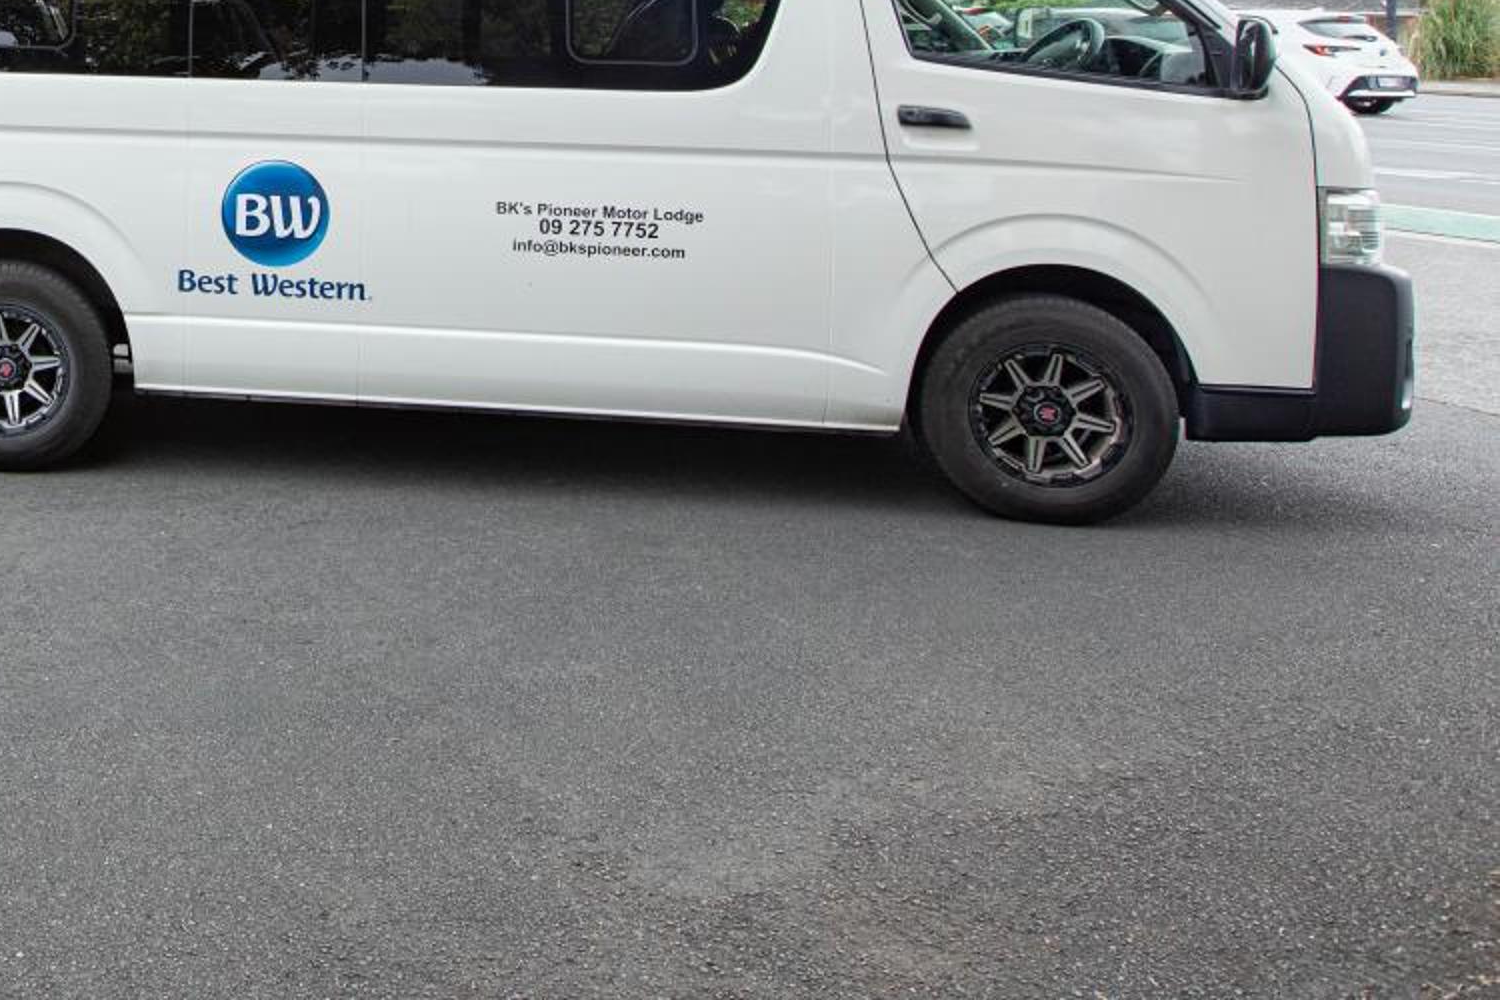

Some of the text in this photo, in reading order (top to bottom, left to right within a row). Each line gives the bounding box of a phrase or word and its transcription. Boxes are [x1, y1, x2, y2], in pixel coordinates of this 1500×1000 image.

[236, 193, 321, 240] BW
[496, 201, 704, 225] BK's Pioneer Motor Lodge
[538, 218, 659, 239] 09 275 7752
[512, 239, 686, 259] info@bkspioneer.com
[178, 269, 238, 294] Best
